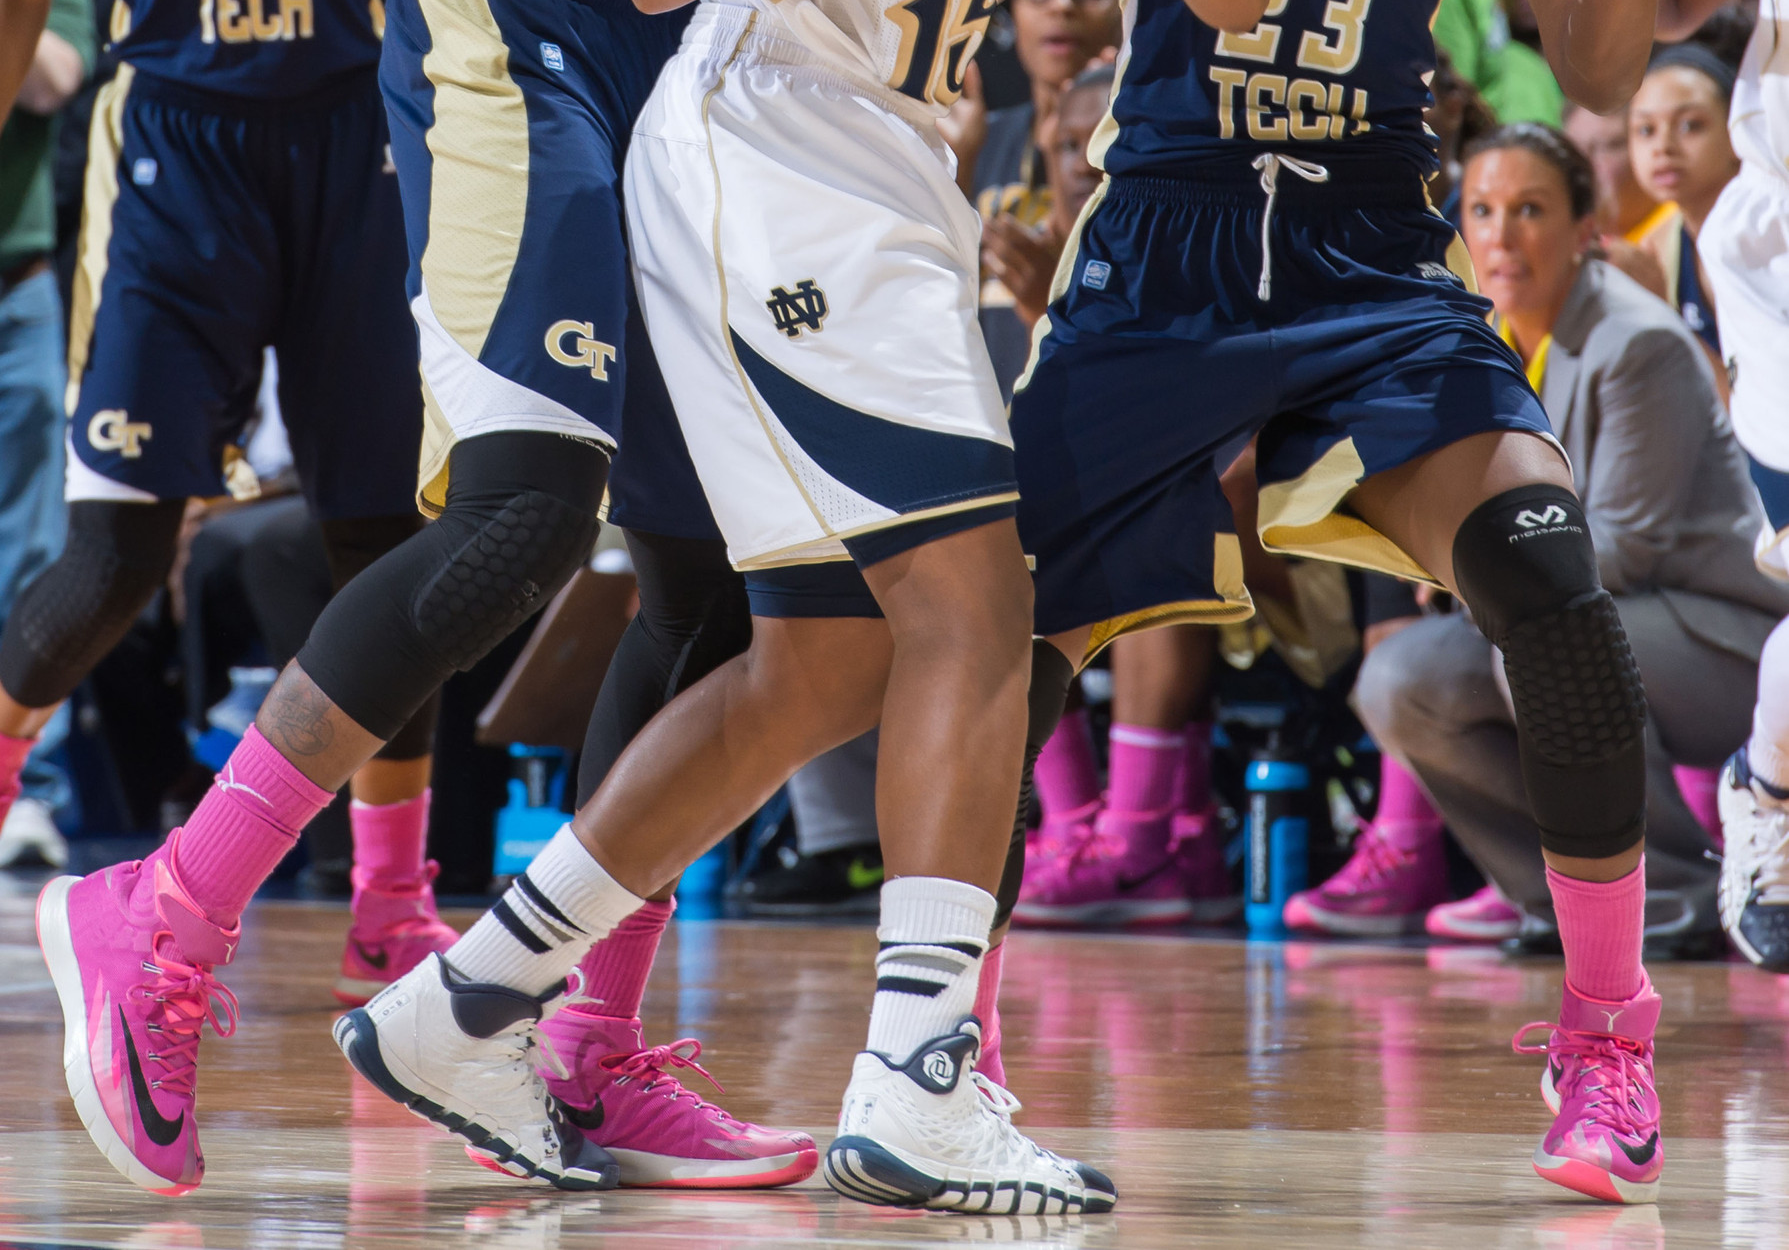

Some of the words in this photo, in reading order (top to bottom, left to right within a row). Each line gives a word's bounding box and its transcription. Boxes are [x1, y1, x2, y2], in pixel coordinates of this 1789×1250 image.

[1208, 66, 1371, 141] TECH
[544, 319, 616, 382] GT
[88, 409, 152, 458] GT
